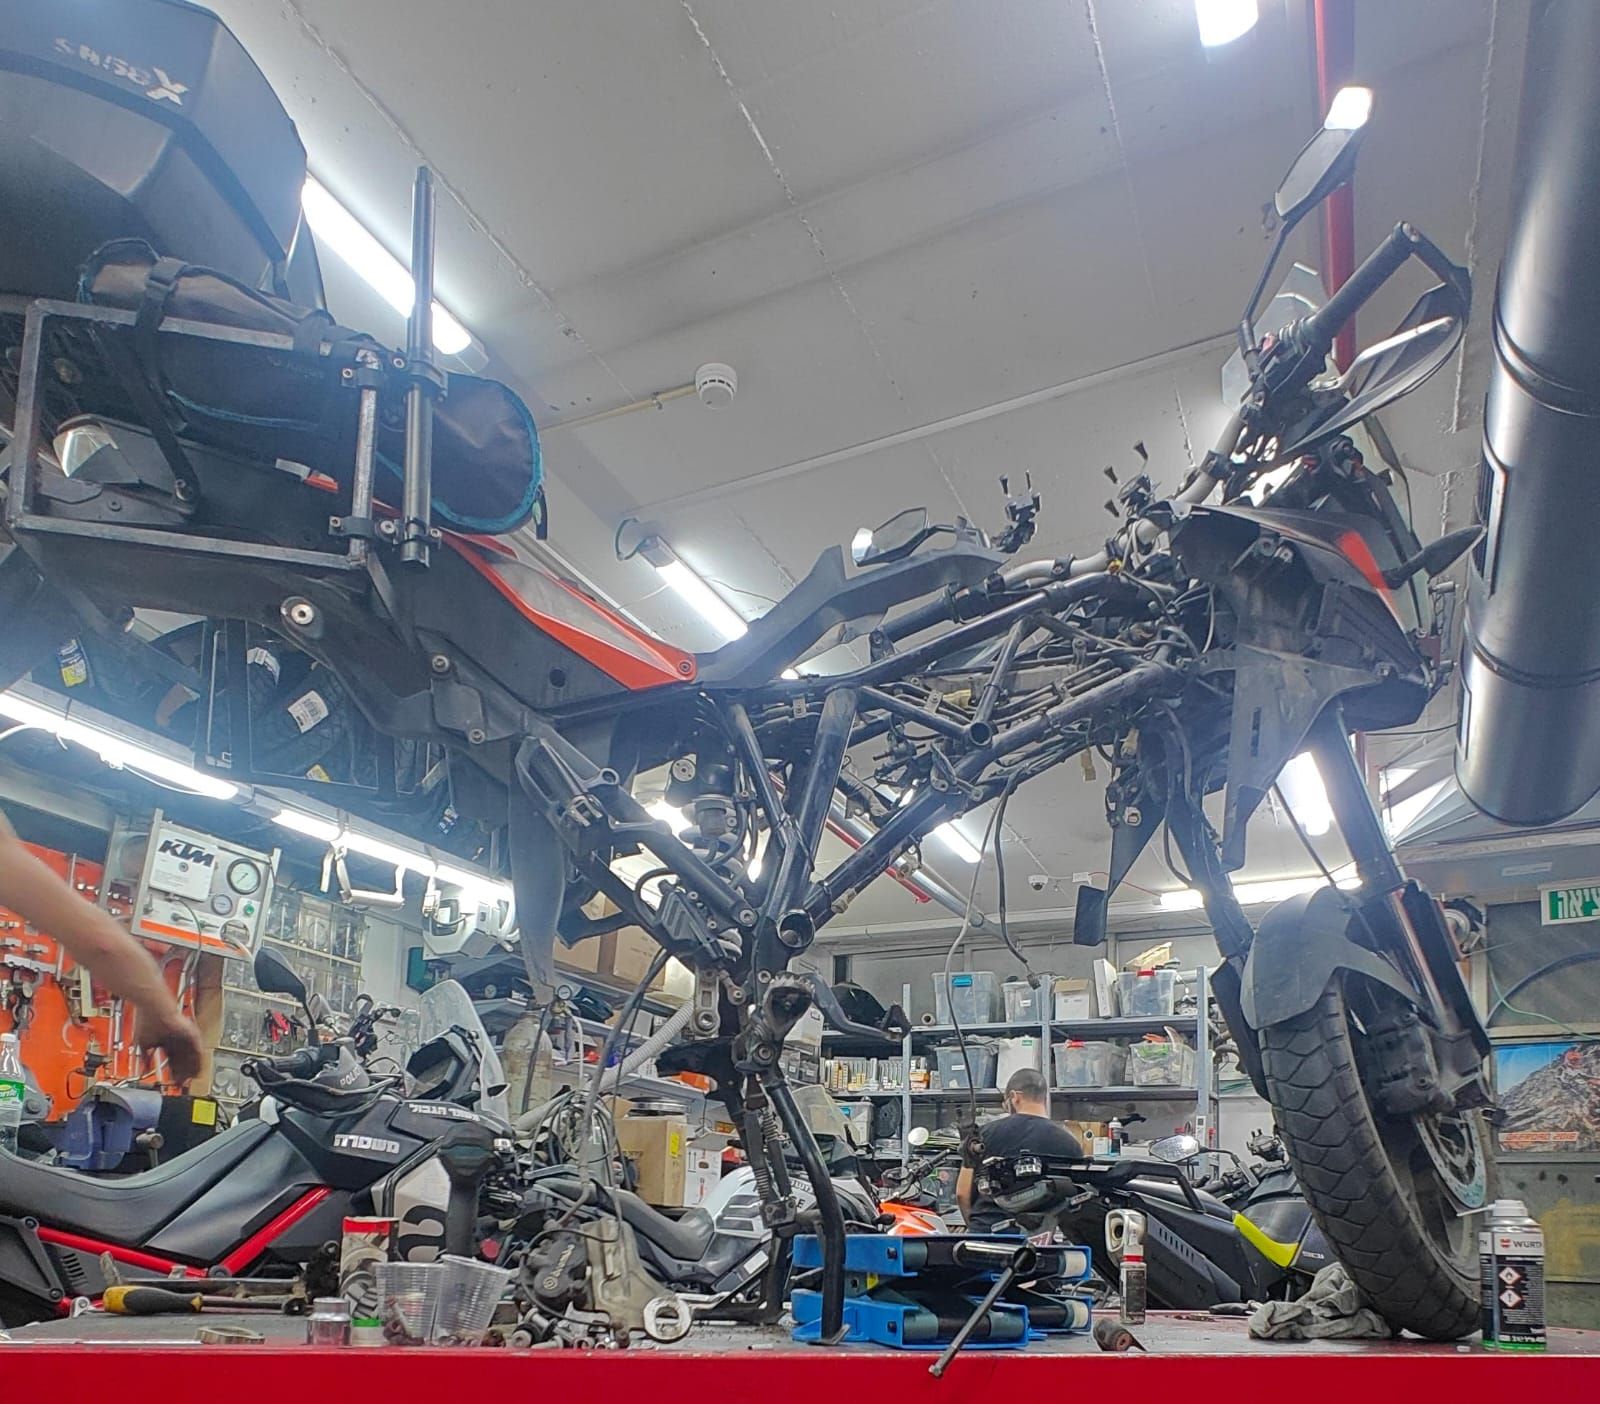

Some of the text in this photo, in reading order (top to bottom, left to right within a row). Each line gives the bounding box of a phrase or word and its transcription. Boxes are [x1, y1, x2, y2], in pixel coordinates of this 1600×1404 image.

[158, 839, 215, 868] KTM
[408, 1103, 447, 1116] הגבול
[333, 1134, 400, 1154] משטרה
